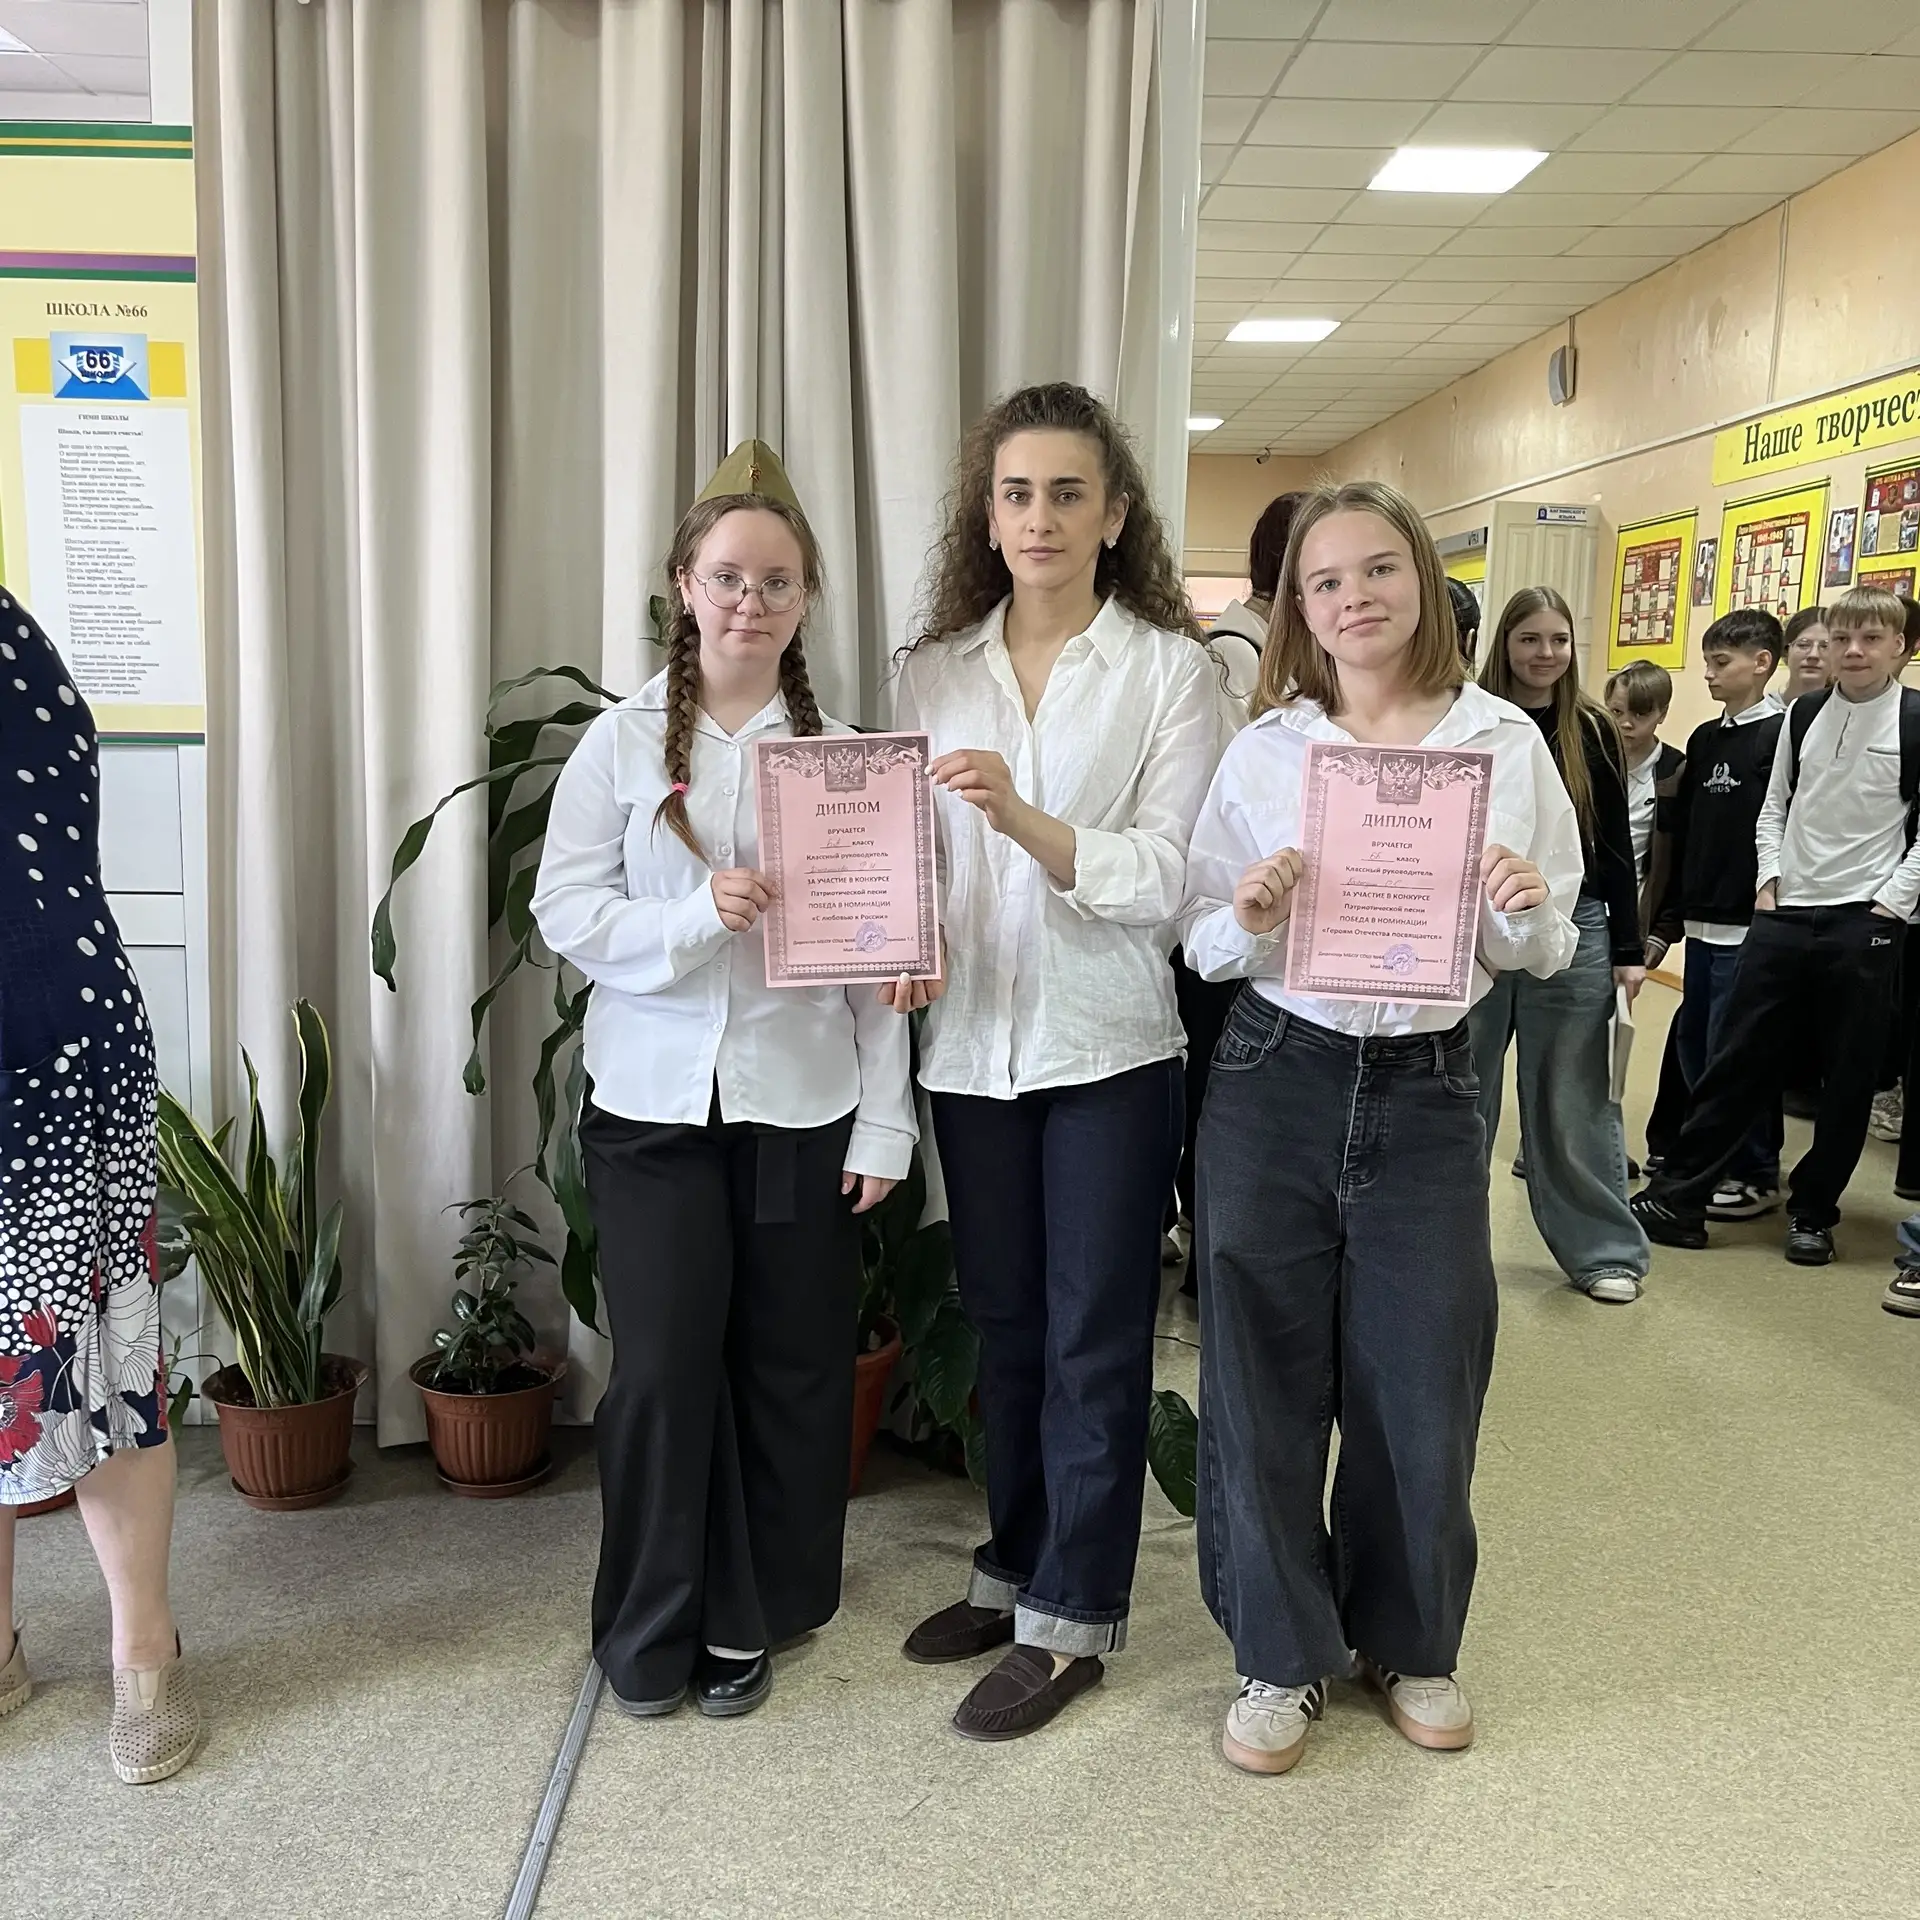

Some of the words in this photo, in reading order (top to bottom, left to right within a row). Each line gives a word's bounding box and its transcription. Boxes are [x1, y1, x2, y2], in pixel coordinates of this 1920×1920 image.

[46, 302, 111, 317] ШКОЛА
[115, 304, 148, 318] №66
[86, 349, 111, 369] 66
[1743, 422, 1803, 465] Наше
[815, 800, 881, 817] ДИПЛОМ
[1361, 813, 1433, 830] ДИПЛОМ
[827, 827, 866, 835] ВРУЧАЕТСЯ
[1371, 841, 1413, 850] ВРУЧАЕТСЯ
[806, 852, 840, 861] Классный
[841, 851, 889, 860] руководитель
[1396, 856, 1421, 864] классу
[1345, 865, 1381, 874] Классный
[1382, 867, 1434, 877] руководитель
[817, 876, 848, 885] УЧАСТИЕ
[855, 875, 890, 884] КОНКУРСЕ
[810, 888, 866, 897] Патриотической
[1353, 891, 1385, 899] УЧАСТИЕ
[1393, 892, 1431, 901] КОНКУРСЕ
[808, 901, 837, 910] ПОБЕДА
[844, 900, 891, 909] НОМИНАЦИИ
[1344, 903, 1403, 912] Патриотической
[1403, 906, 1426, 914] песни
[821, 913, 853, 921] любовью
[1340, 915, 1370, 924] ПОБЕДА
[1377, 918, 1428, 927] НОМИНАЦИИ
[1322, 927, 1353, 937] «Героям
[1354, 928, 1390, 937] Отечества
